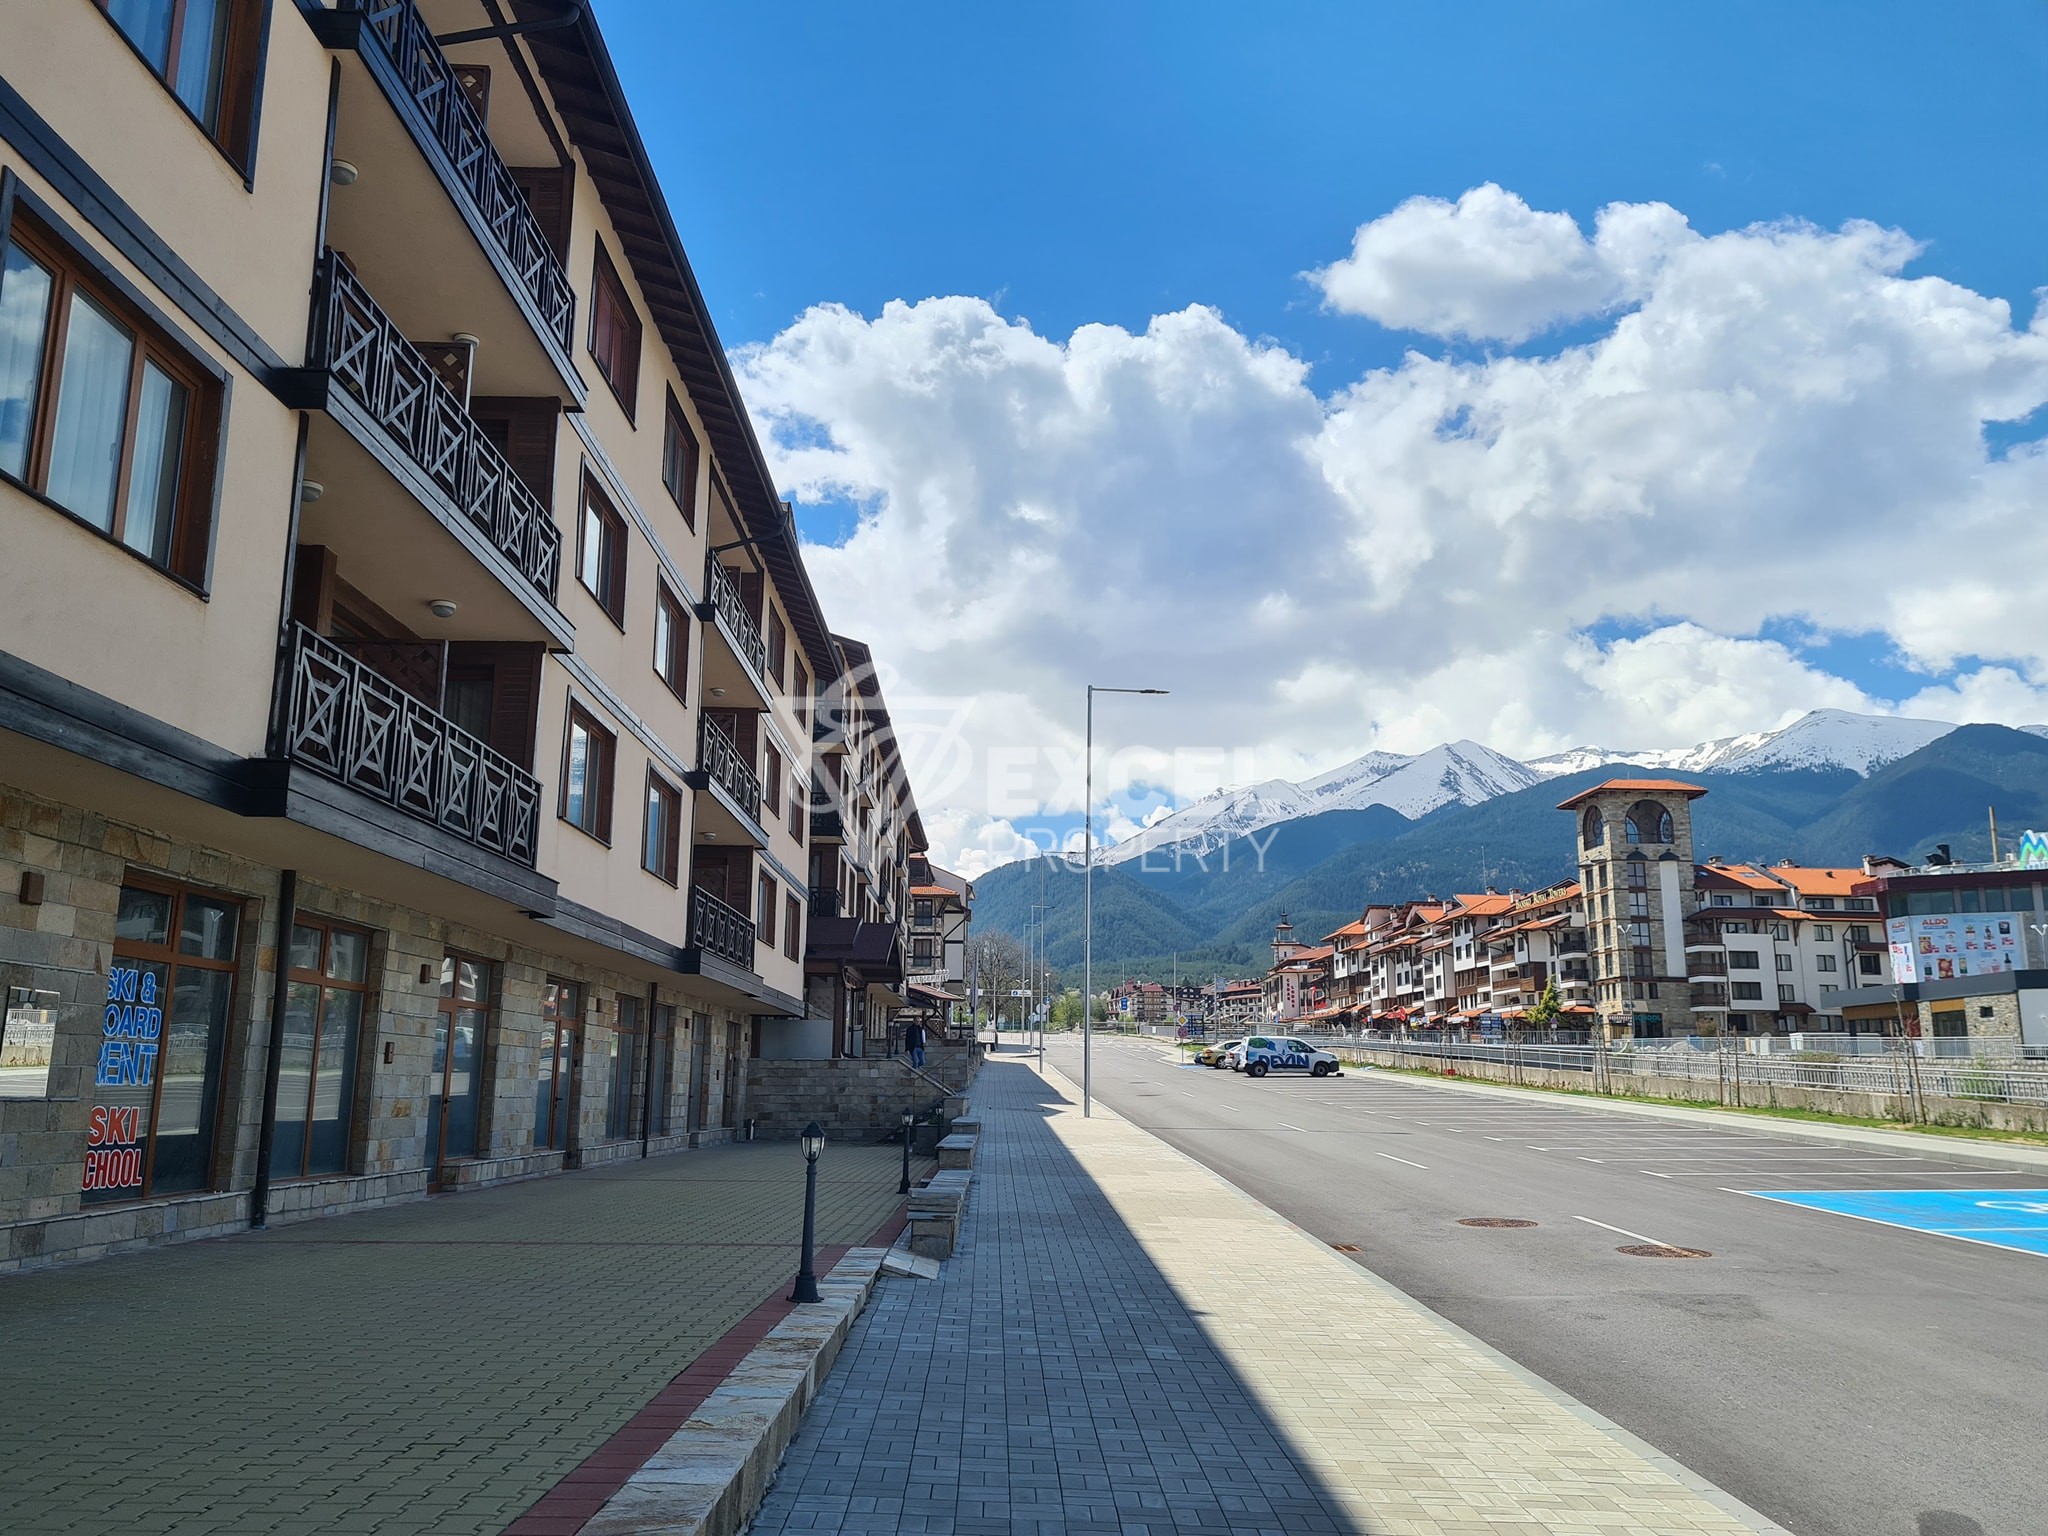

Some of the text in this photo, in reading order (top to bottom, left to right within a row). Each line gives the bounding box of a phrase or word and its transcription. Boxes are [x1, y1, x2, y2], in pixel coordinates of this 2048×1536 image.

[1922, 917, 1949, 926] ALDO
[107, 966, 156, 1004] SKI &
[103, 1003, 162, 1040] OARD
[88, 1105, 140, 1146] SKI
[81, 1148, 142, 1190] CHOOL
